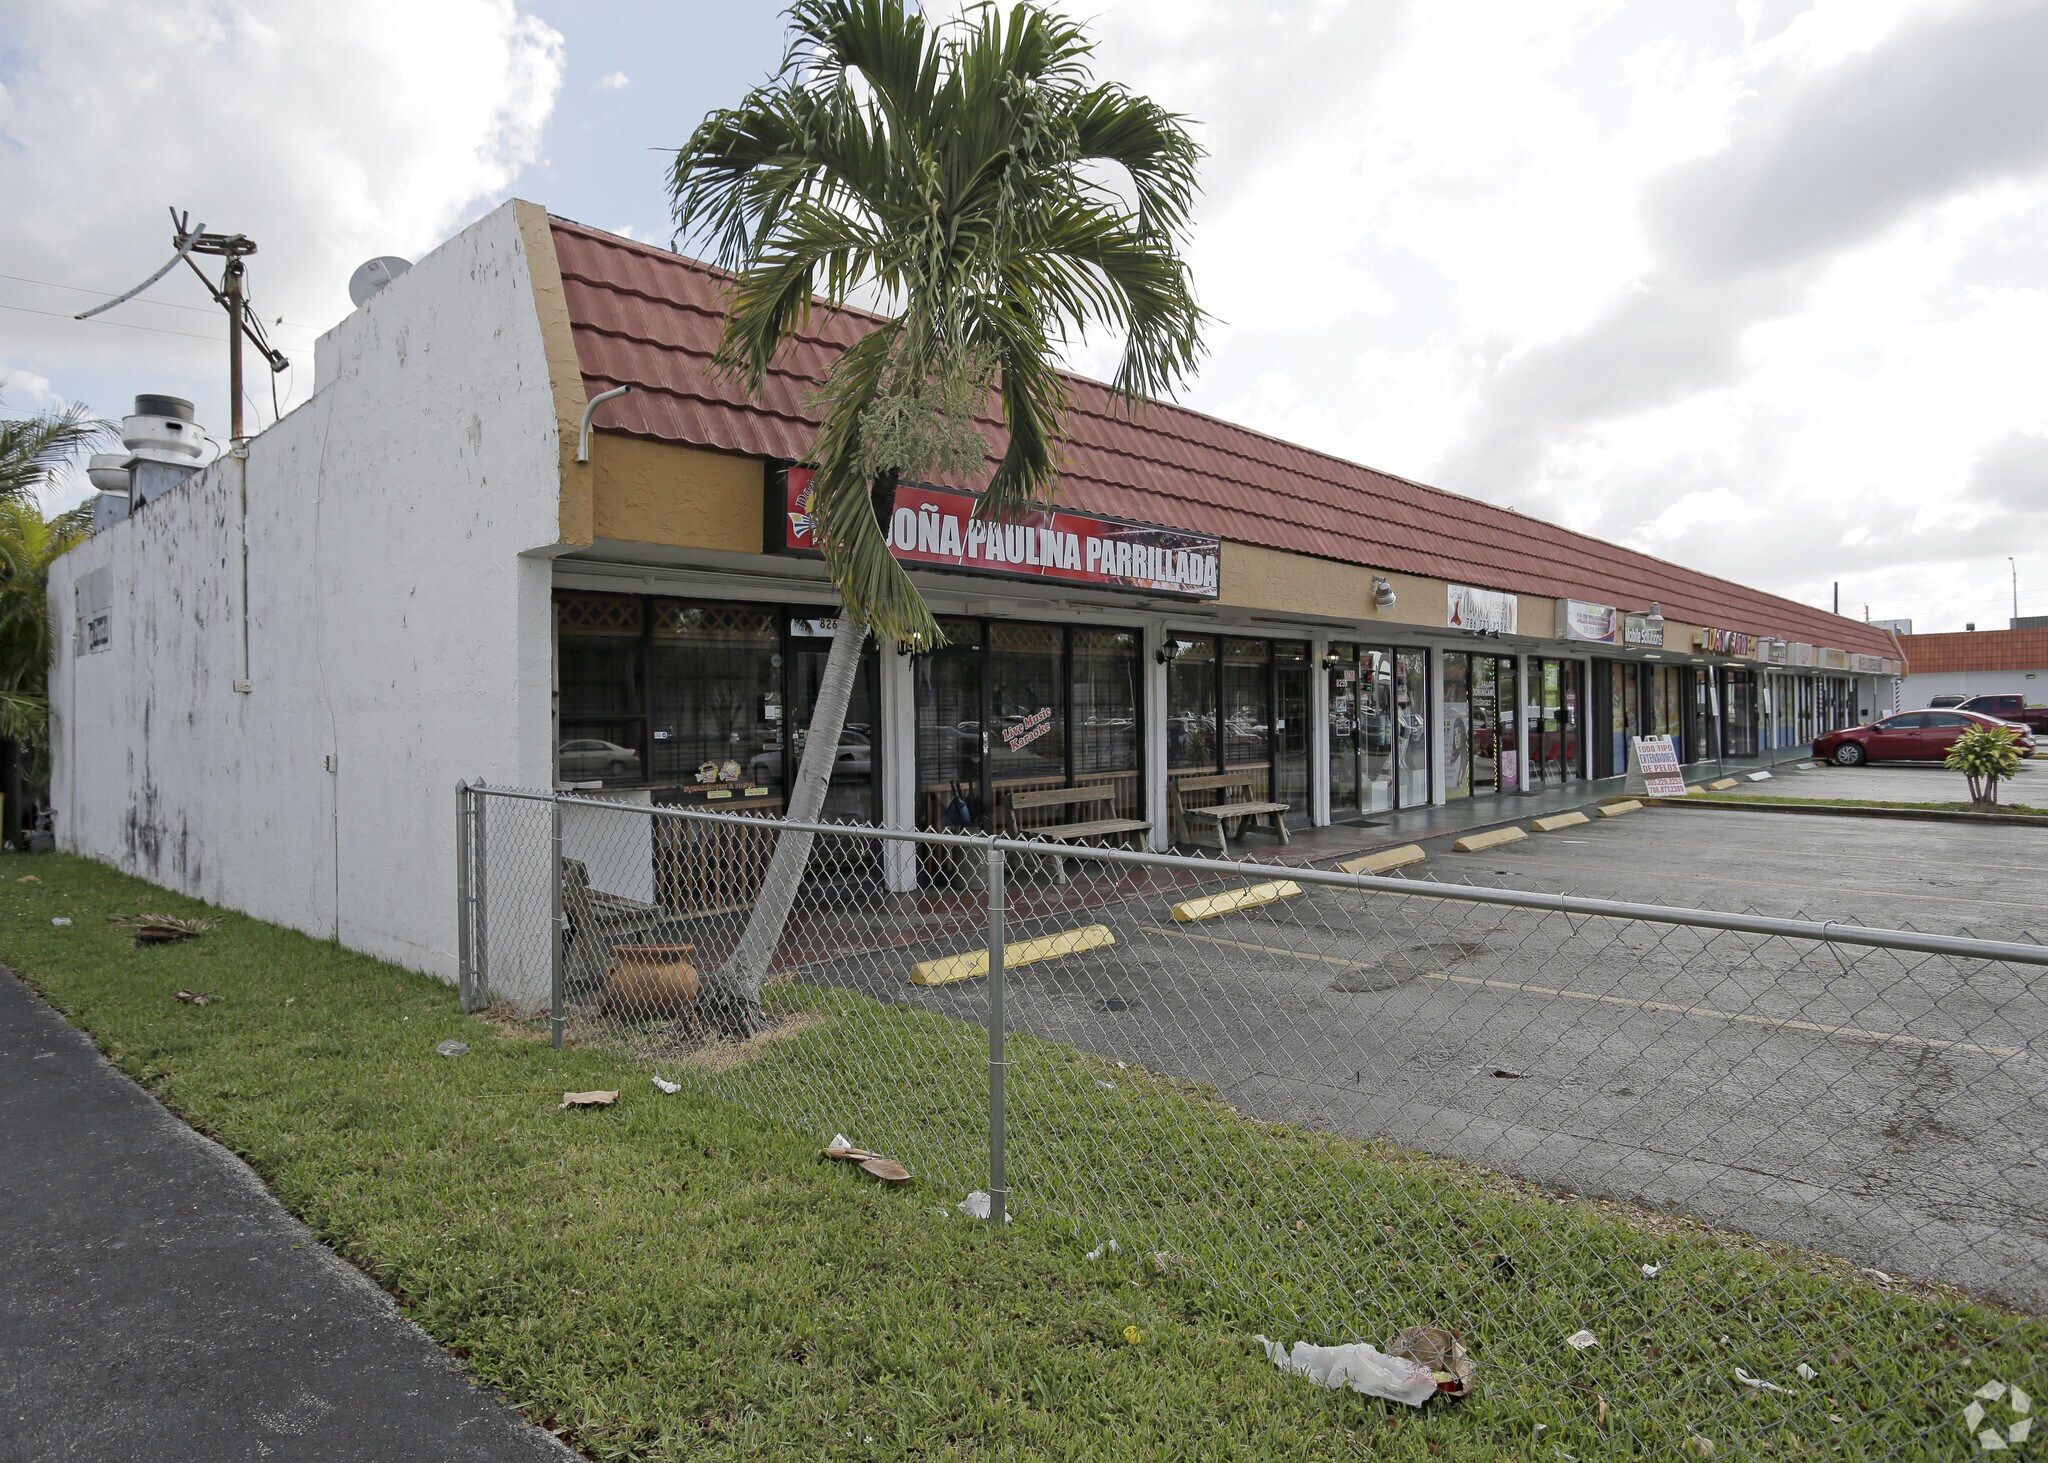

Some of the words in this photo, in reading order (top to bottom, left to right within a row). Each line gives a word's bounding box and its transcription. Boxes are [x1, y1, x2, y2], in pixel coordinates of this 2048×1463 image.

[967, 518, 1082, 572] PAULINA
[1086, 536, 1217, 588] PARRILLADA
[1002, 724, 1025, 742] Live
[1023, 707, 1051, 730] Music
[1010, 723, 1051, 752] Karaoke
[1637, 745, 1656, 753] TODO
[1657, 744, 1673, 752] TIPO
[1639, 752, 1676, 764] EXTENSIONES
[1642, 764, 1653, 773] DE
[1654, 763, 1678, 772] PELOS
